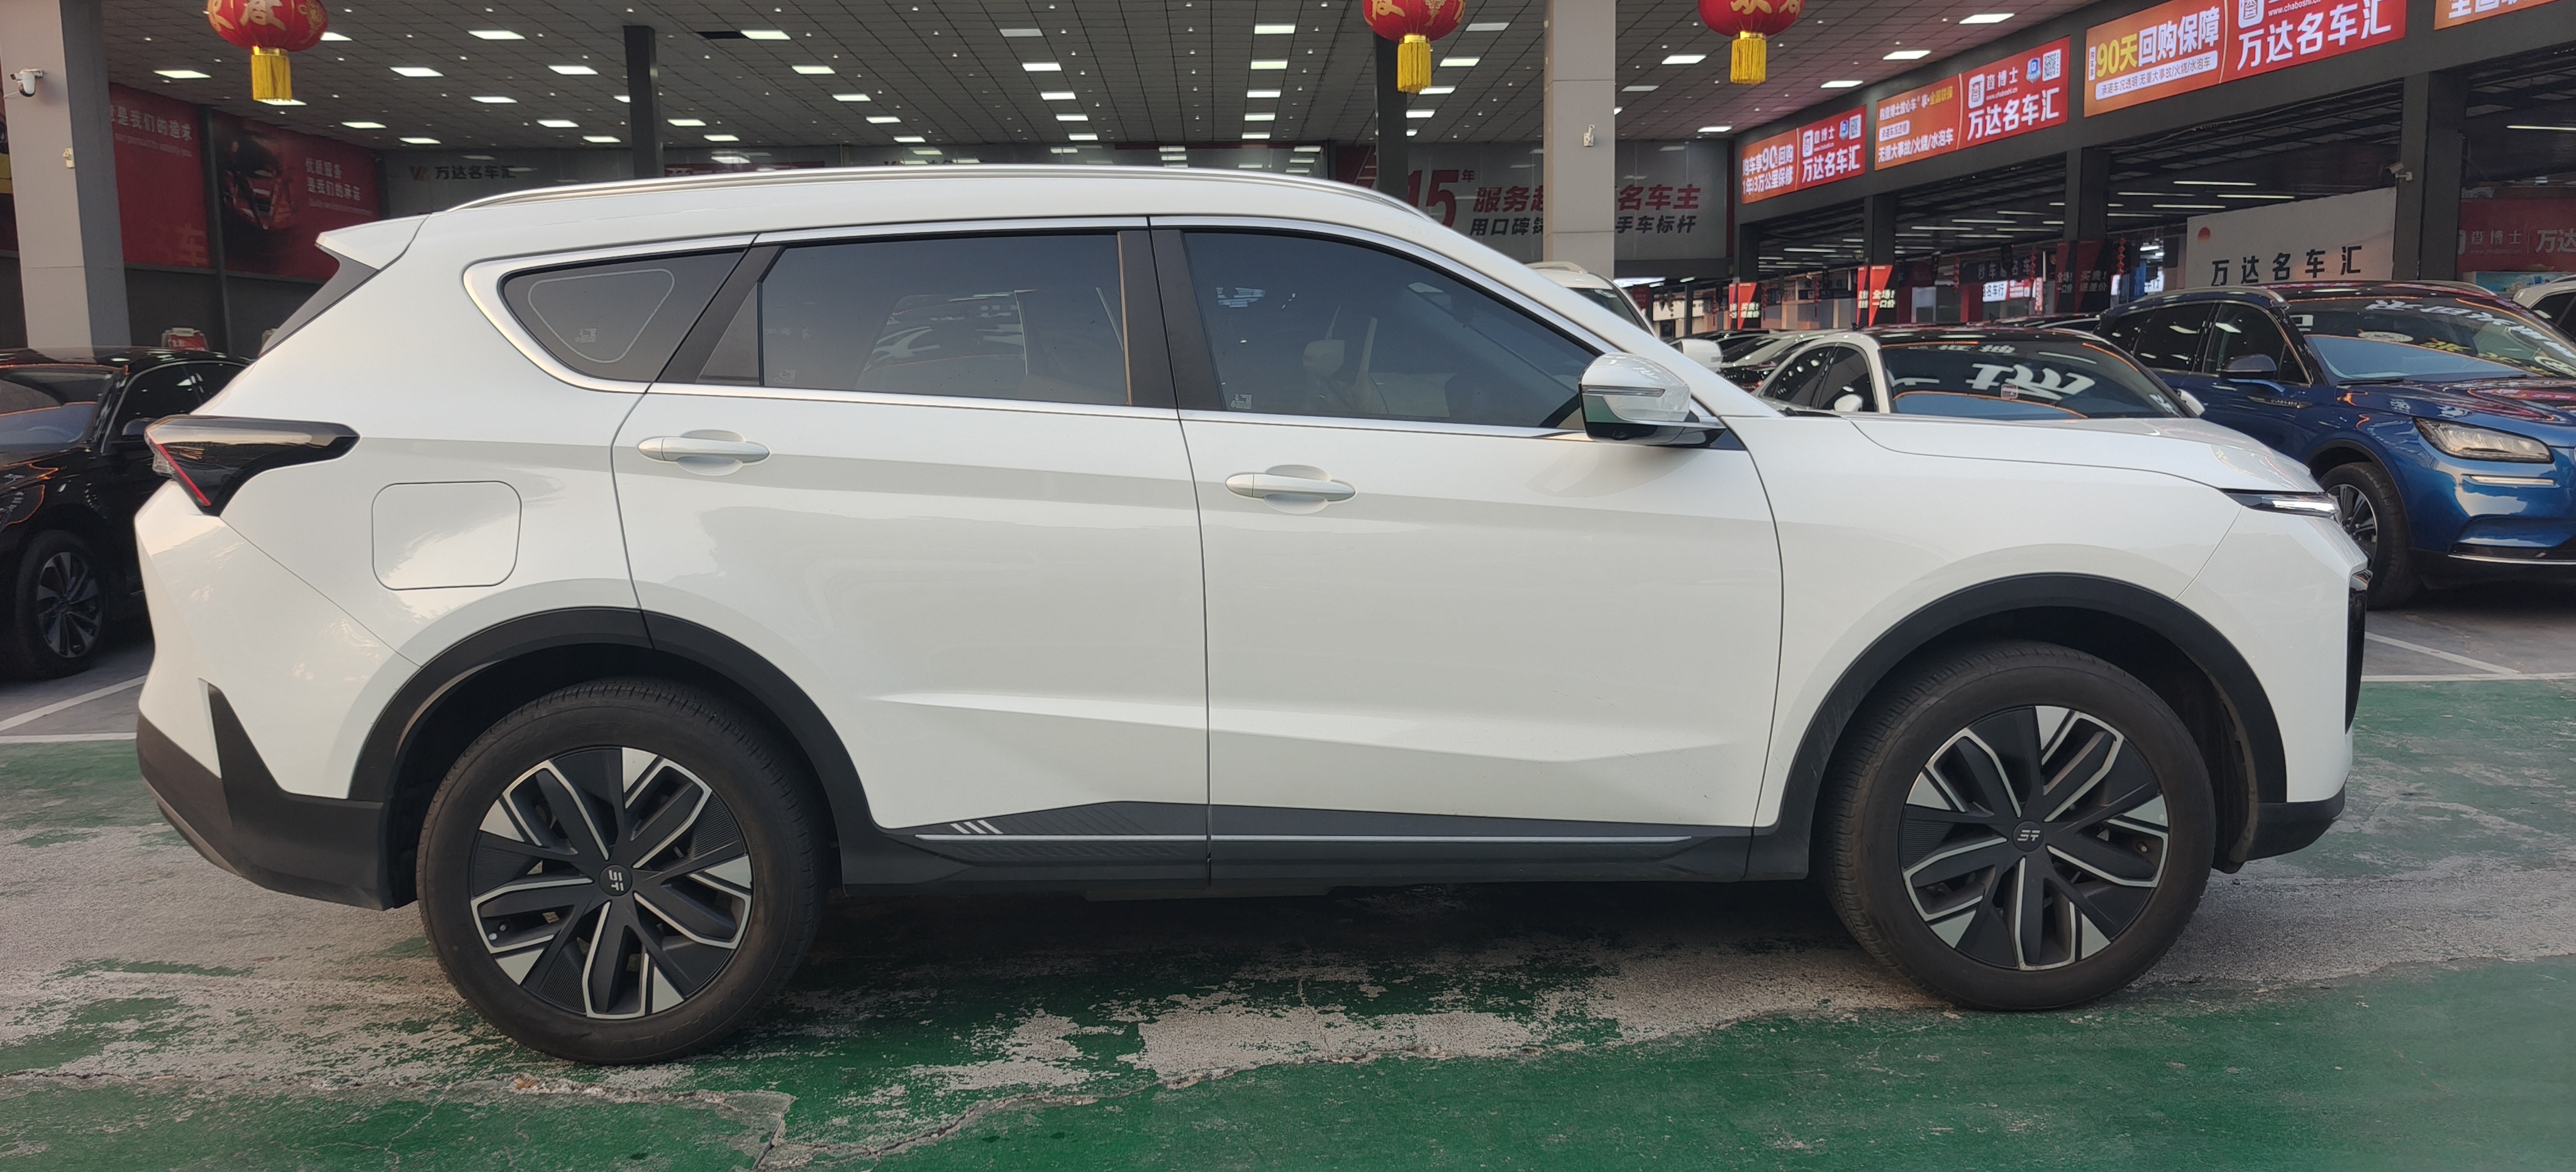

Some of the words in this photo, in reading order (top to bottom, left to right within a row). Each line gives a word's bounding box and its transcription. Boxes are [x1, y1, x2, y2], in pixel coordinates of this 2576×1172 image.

[2096, 6, 2219, 78] 90天回购保障
[2237, 0, 2391, 71] 万达名车汇
[1986, 67, 2018, 91] 查博士
[1967, 87, 2060, 141] 万达名车汇
[434, 165, 516, 180] 万达名车汇
[1802, 144, 1861, 183] 万达名车汇
[2211, 245, 2362, 287] 万达名车汇
